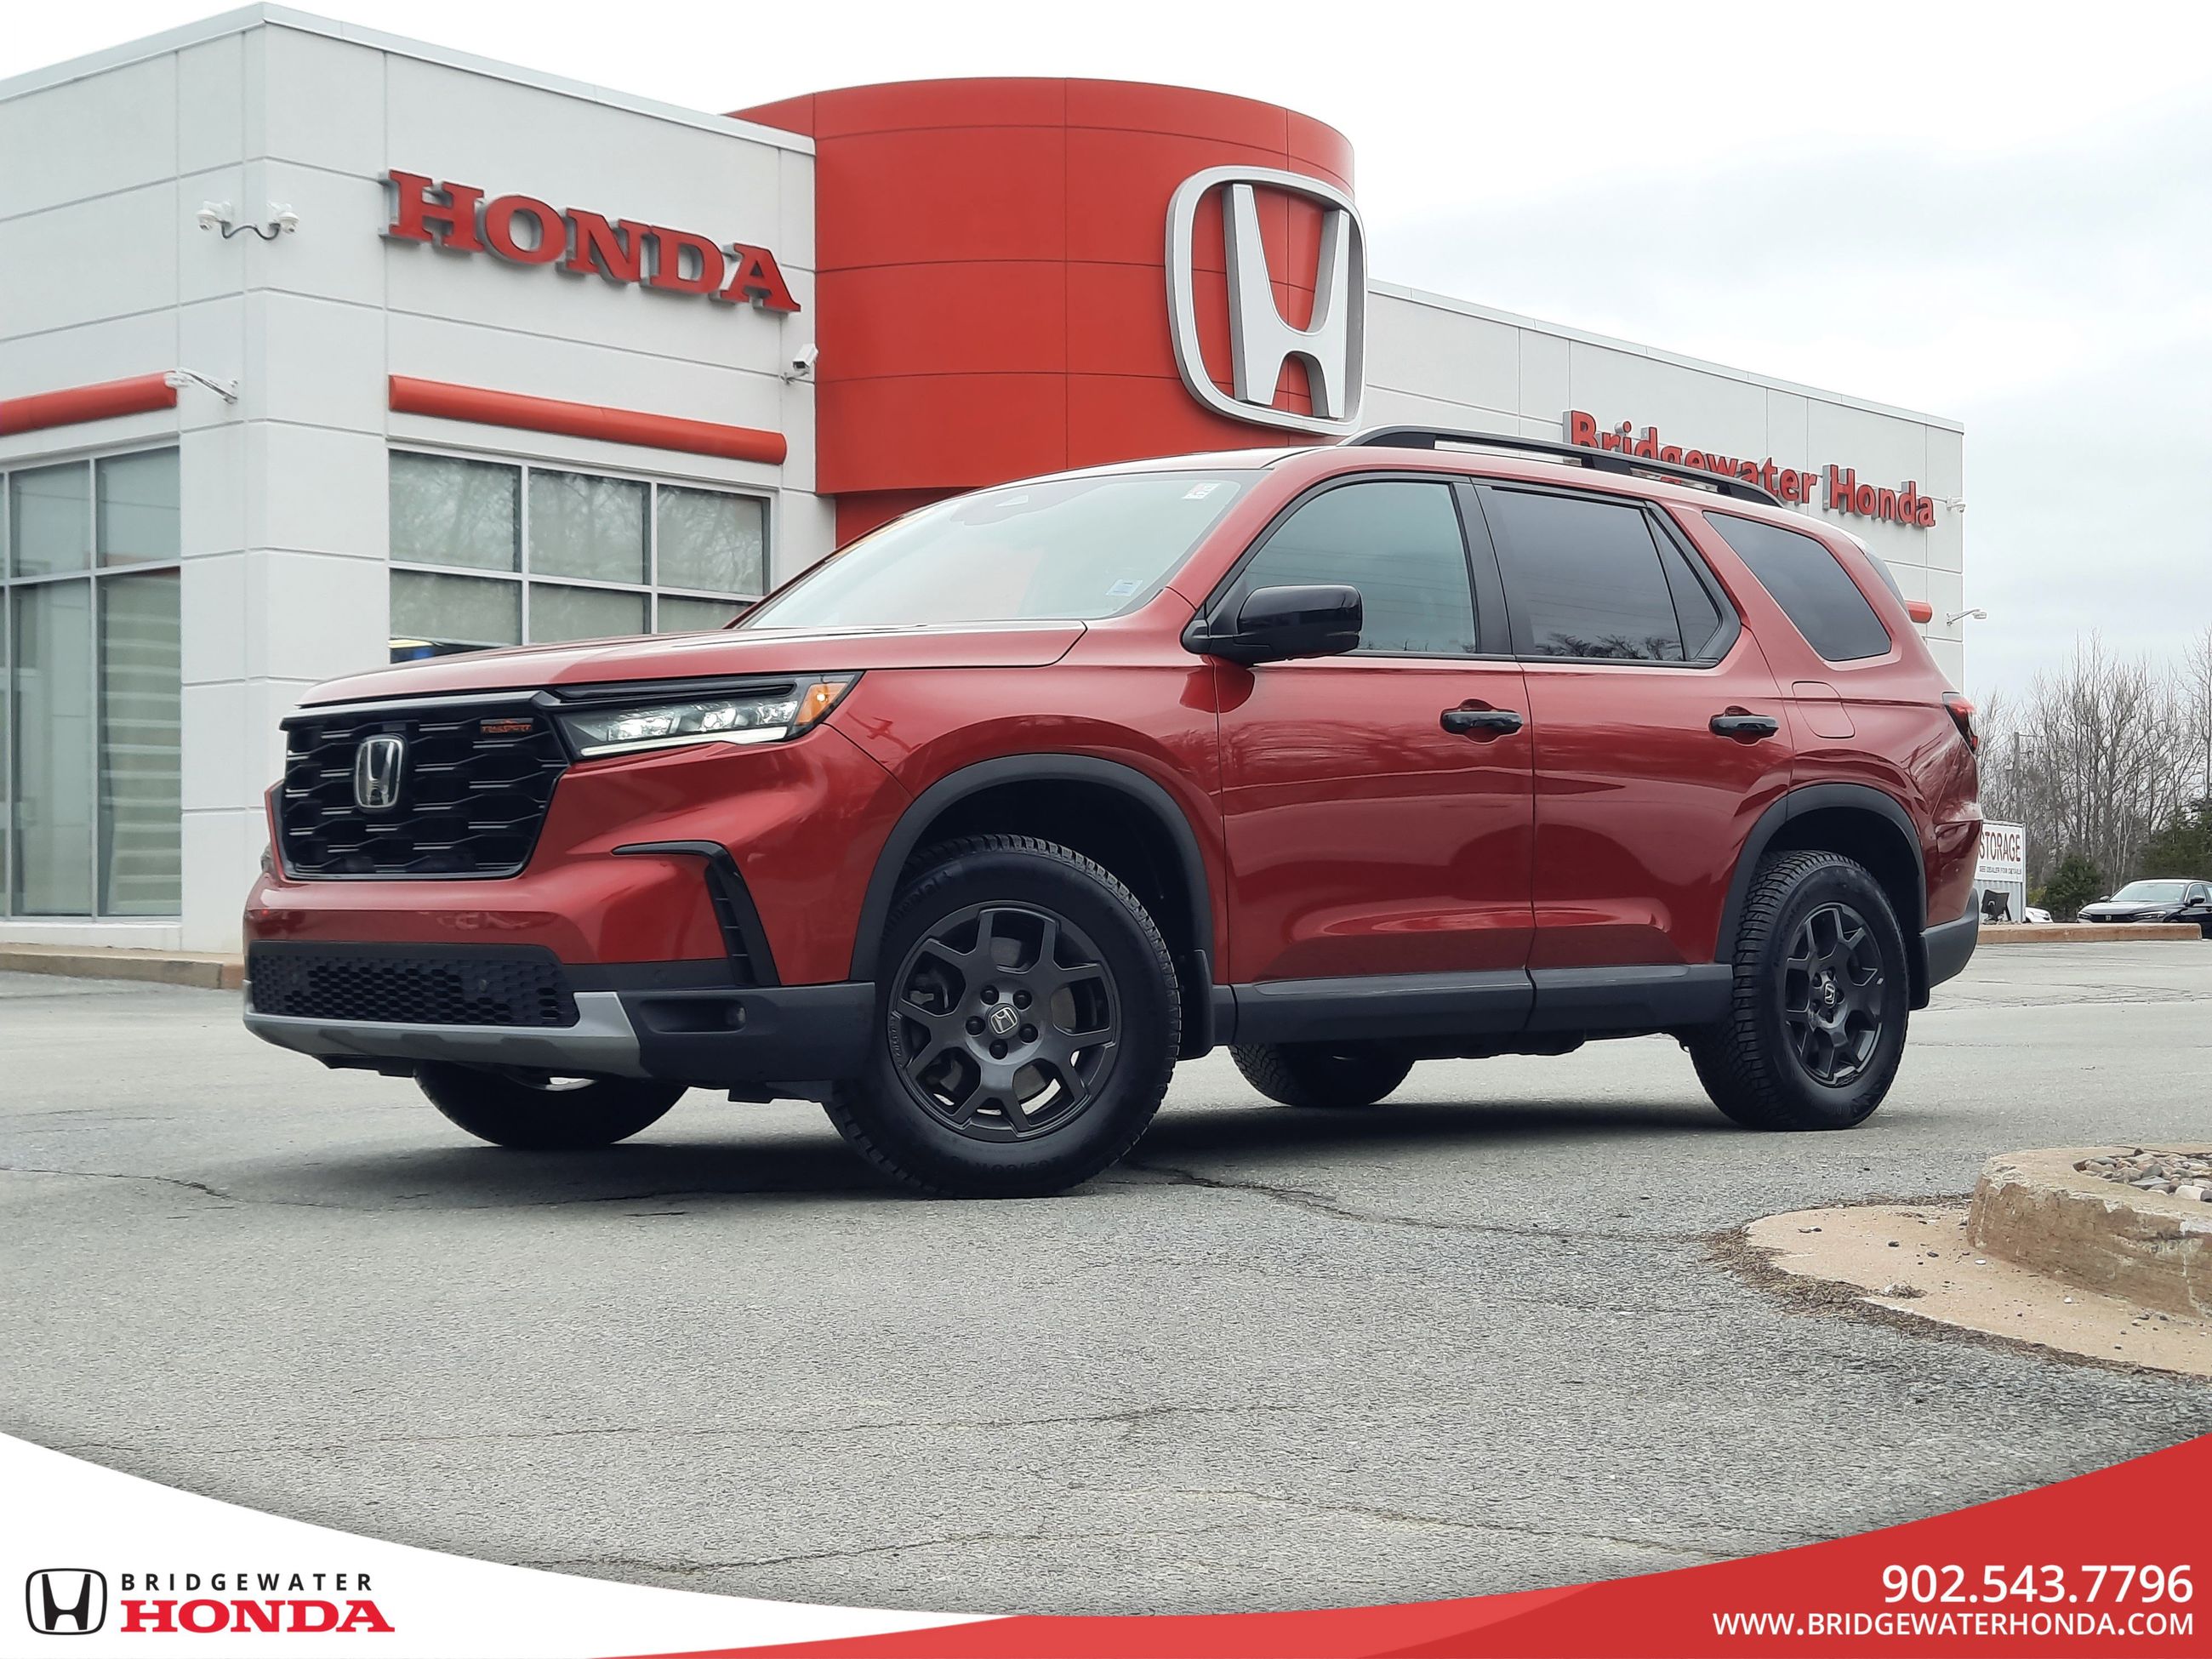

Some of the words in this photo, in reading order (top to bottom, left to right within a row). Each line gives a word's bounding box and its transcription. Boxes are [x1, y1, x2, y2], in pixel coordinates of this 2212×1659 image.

[389, 169, 801, 312] HONDA
[1828, 465, 1936, 527] Honda
[1979, 831, 2021, 862] STORAGE
